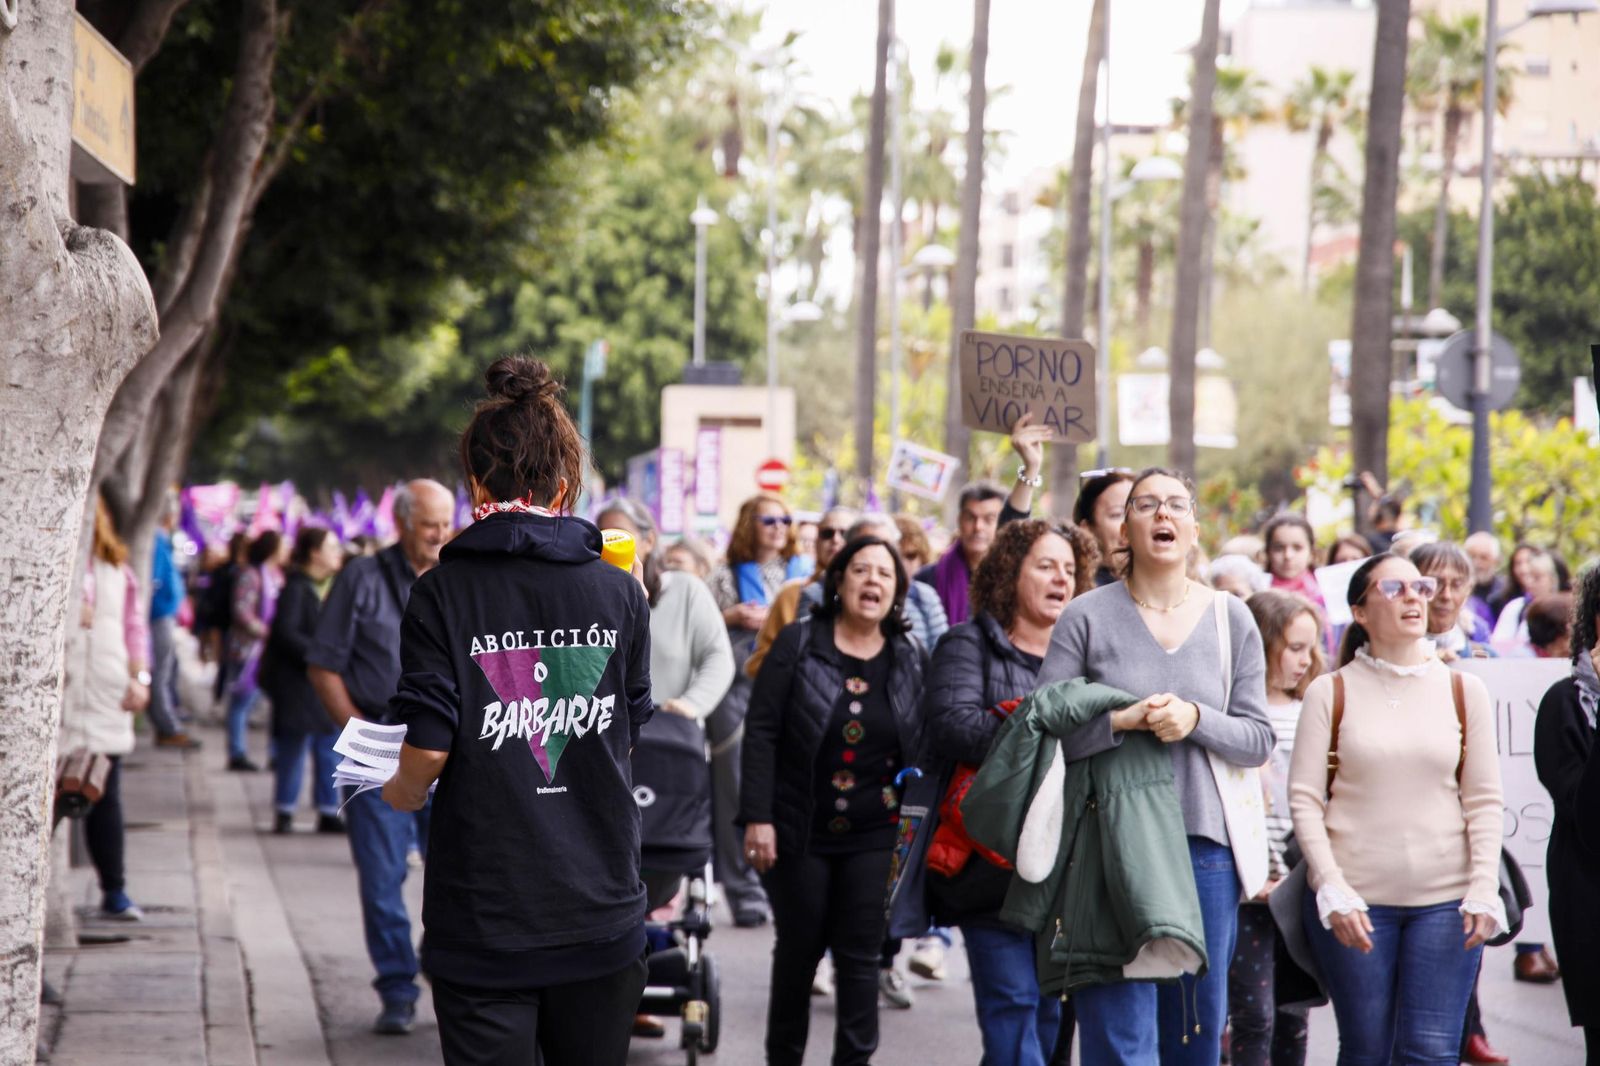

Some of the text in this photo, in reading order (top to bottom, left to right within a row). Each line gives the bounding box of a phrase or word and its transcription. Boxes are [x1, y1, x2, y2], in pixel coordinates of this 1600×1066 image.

[976, 341, 1082, 386] PORNO
[969, 392, 1090, 436] VIOAR
[1053, 386, 1068, 404] A
[469, 622, 618, 656] ABOLICIÓN
[533, 661, 548, 682] O
[478, 694, 616, 750] BARBARIE
